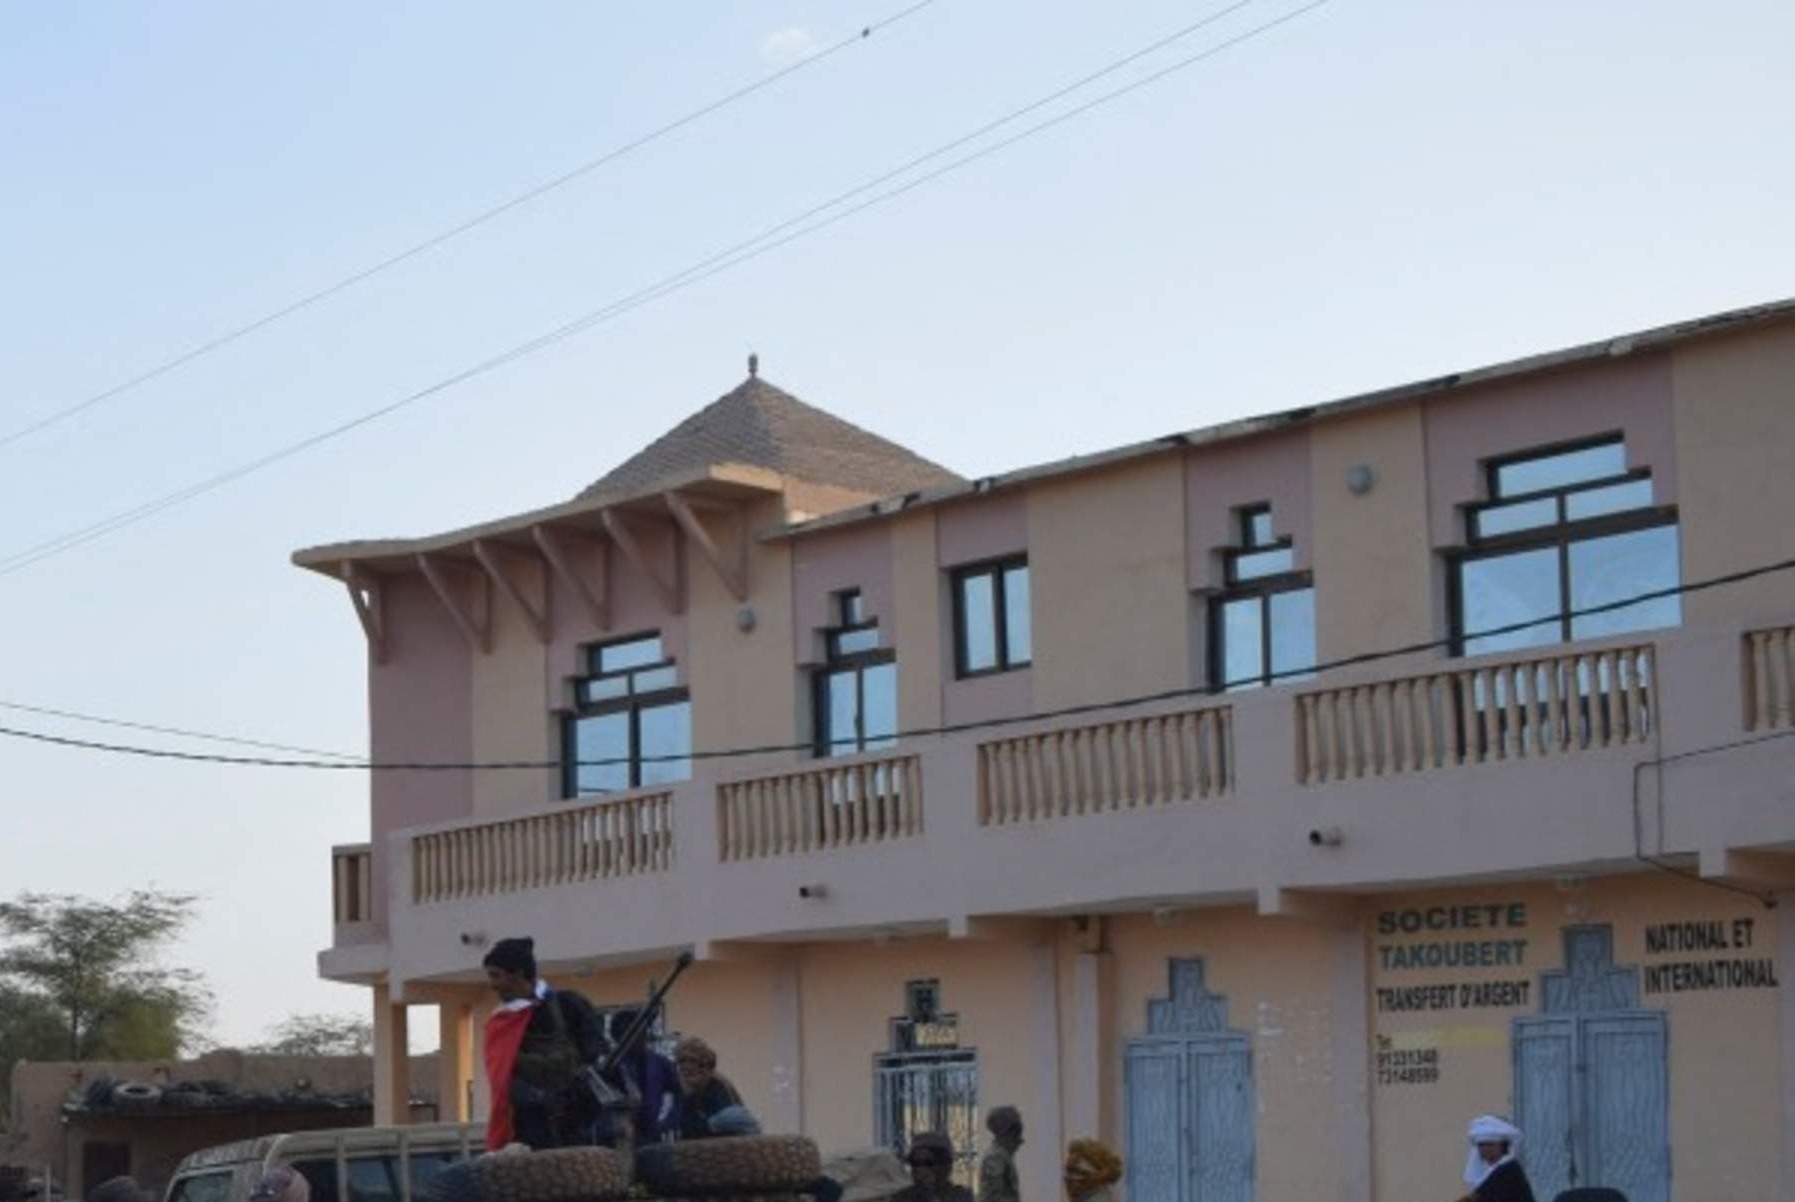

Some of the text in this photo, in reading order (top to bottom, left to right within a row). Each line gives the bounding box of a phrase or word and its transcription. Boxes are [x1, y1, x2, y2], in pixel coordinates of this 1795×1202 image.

[1378, 903, 1527, 933] SOCIETE
[1645, 918, 1754, 954] NATIONAL ET
[1378, 940, 1528, 970] TAKOUBERT
[1644, 959, 1778, 994] INTERNATIONAL
[1376, 980, 1529, 1011] TRANSFERT D'ARGENT
